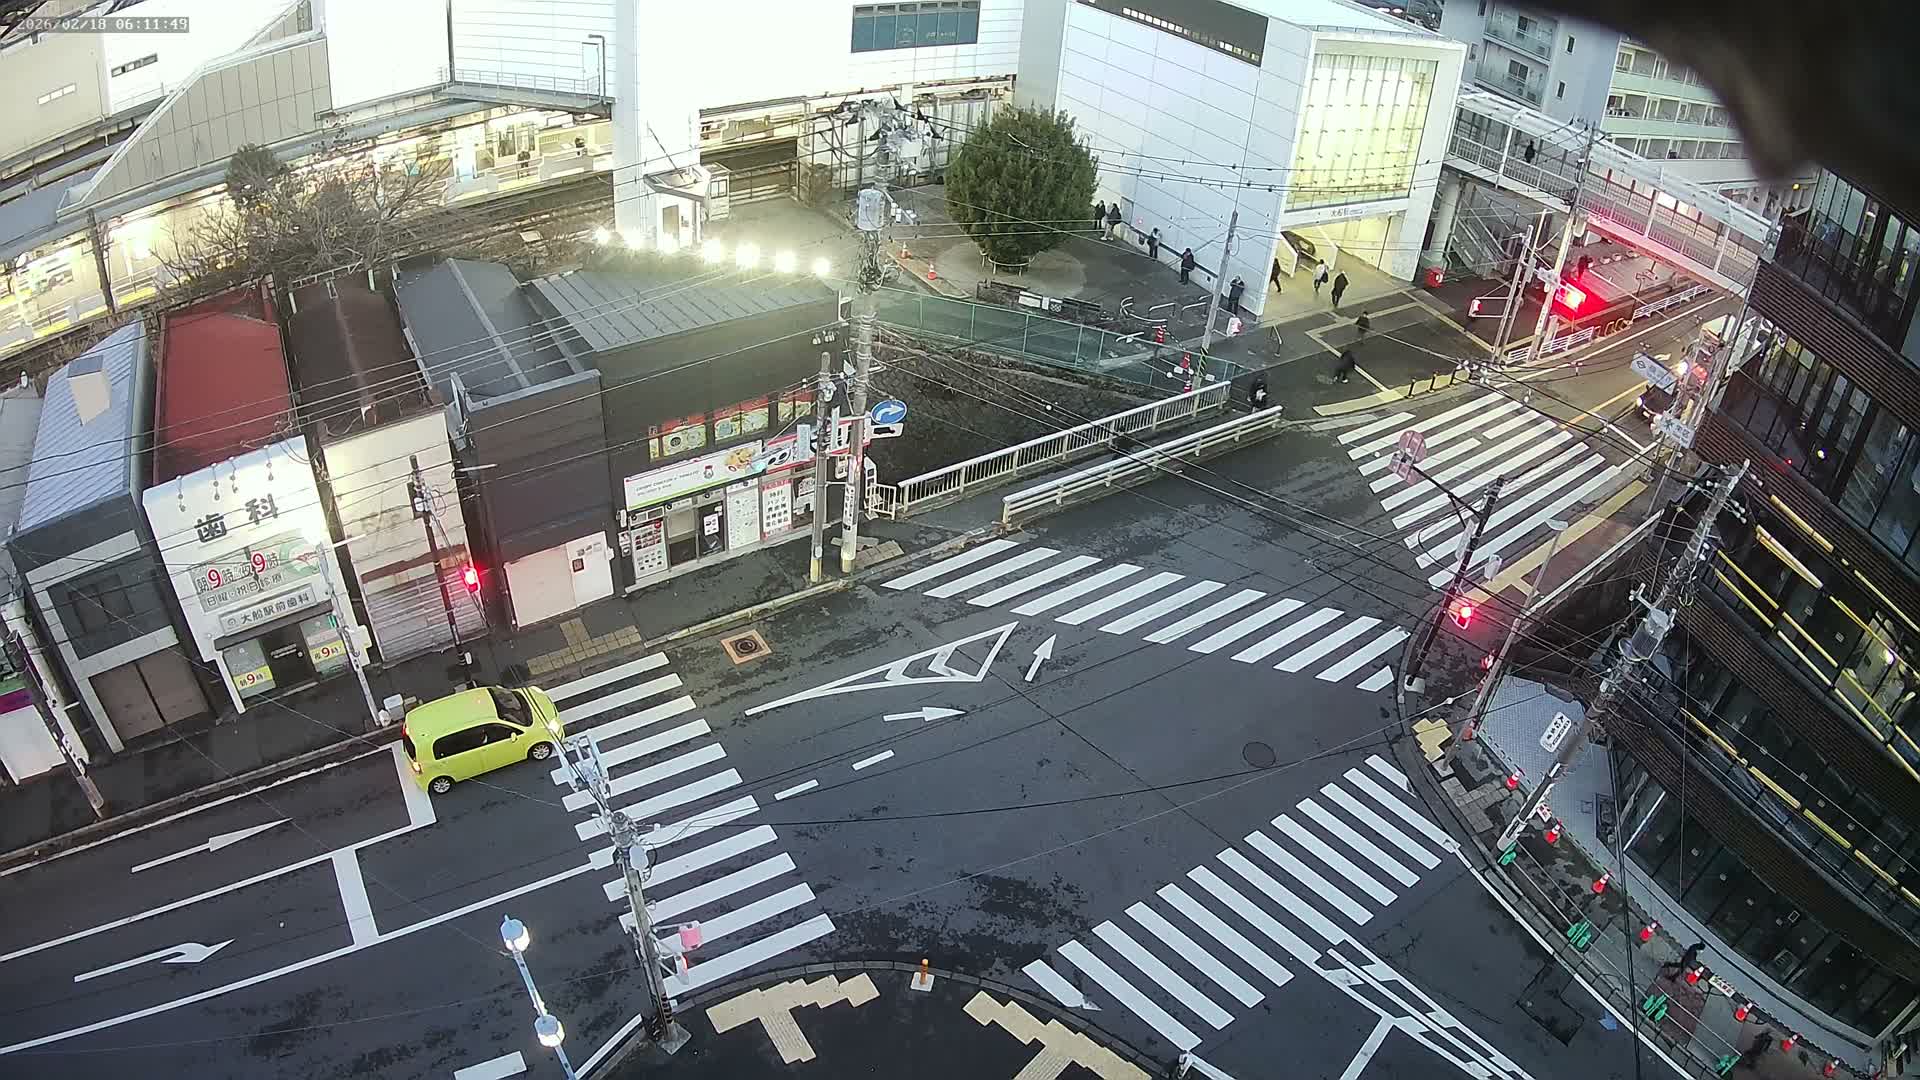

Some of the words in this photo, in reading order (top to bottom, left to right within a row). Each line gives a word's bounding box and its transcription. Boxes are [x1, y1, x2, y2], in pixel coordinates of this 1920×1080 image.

[194, 493, 278, 542] 歯科
[240, 592, 310, 625] 大船駅前歯科
